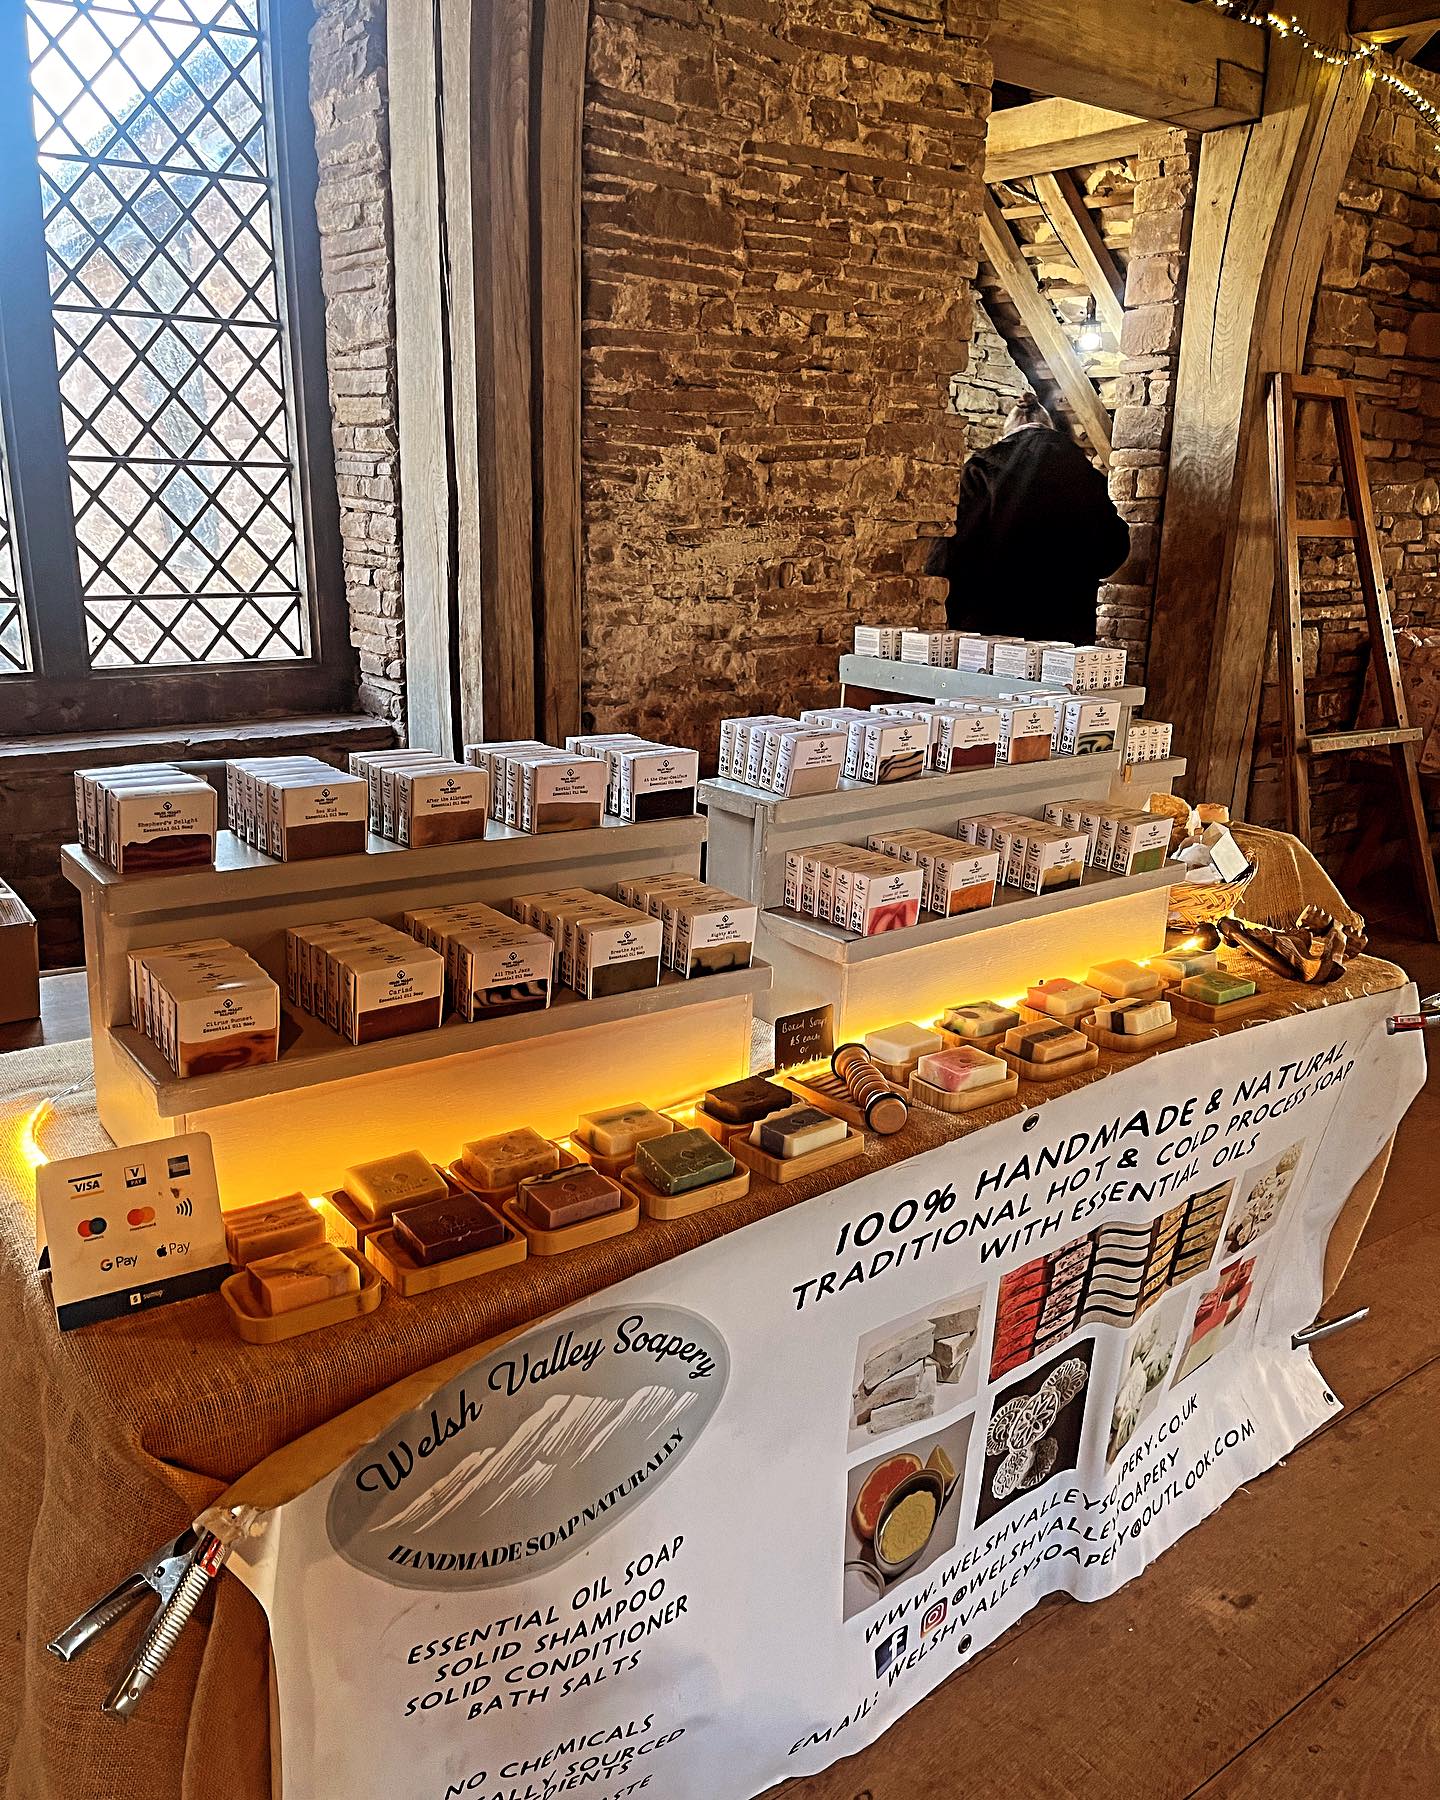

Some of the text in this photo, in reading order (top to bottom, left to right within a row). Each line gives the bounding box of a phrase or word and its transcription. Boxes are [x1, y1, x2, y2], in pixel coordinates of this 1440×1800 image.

[138, 818, 198, 830] Shepherd's Delight
[206, 1020, 230, 1028] Citrus
[388, 986, 414, 996] Cariad
[74, 1180, 100, 1193] VISA
[791, 1059, 1356, 1311] TRADITIONAL HOT & COLD PROCESS SOAP
[835, 1039, 1349, 1256] 100% HANDMADE & NATURAL
[979, 1132, 1261, 1264] WITH ESSENTIAL OILS
[116, 1255, 138, 1268] Pay
[168, 1242, 190, 1256] Pay
[355, 1314, 718, 1492] Welsh Valley Soapery
[387, 1428, 686, 1572] HANDMADE SOAP NATURALLY
[406, 1535, 685, 1665] ESSENTIAL OIL SOAP
[434, 1578, 666, 1683] SOLID SHAMPOO
[403, 1594, 690, 1718] SOLID CONDITIONER
[466, 1649, 643, 1721] BATH SALTS
[444, 1712, 655, 1800] NO CHEMICALS
[564, 1728, 687, 1778] SOURCED
[788, 1690, 880, 1756] EMAIL:
